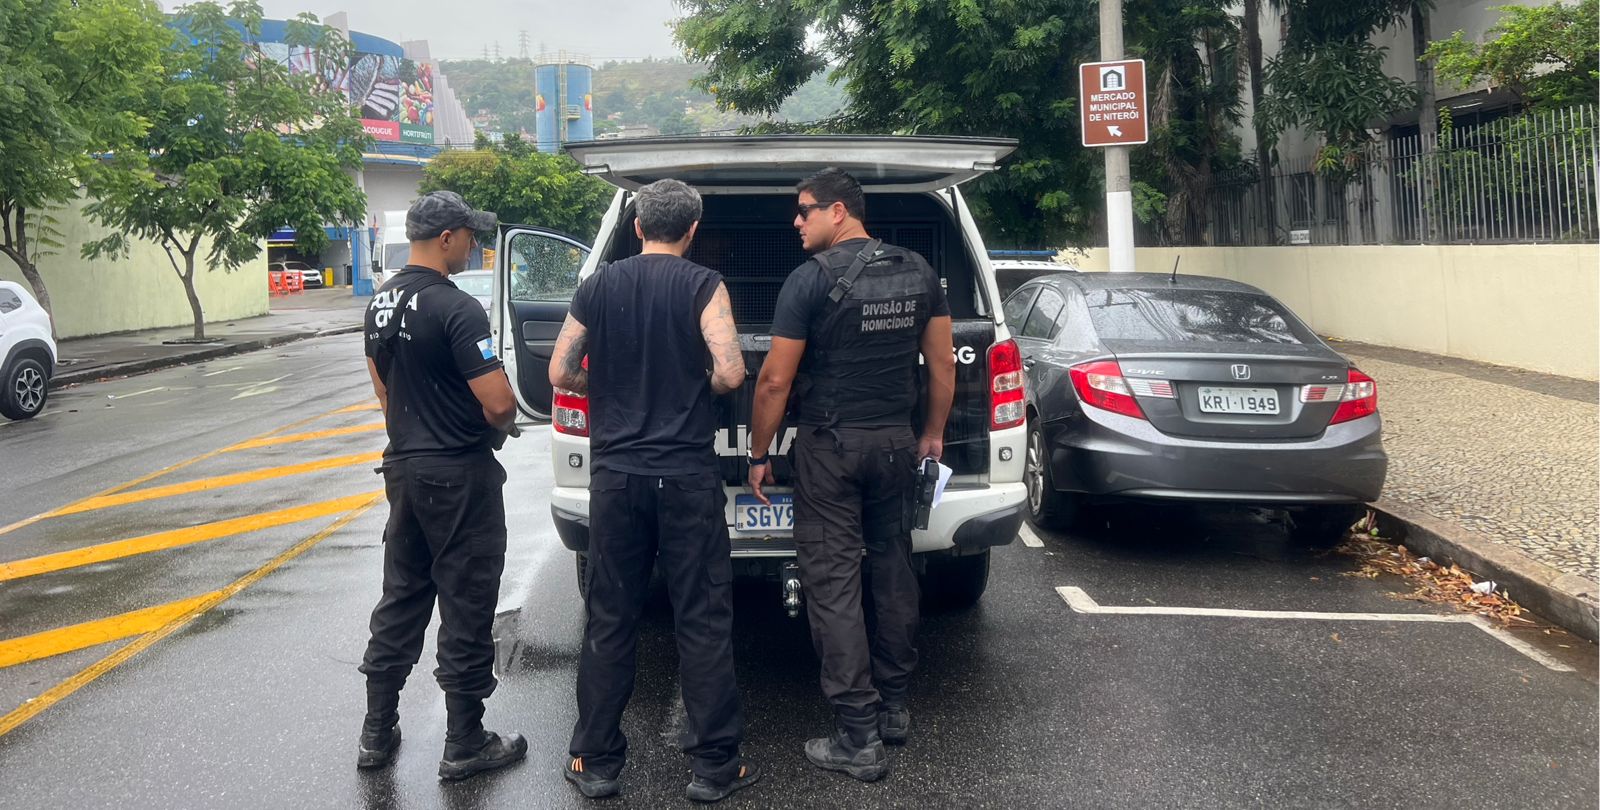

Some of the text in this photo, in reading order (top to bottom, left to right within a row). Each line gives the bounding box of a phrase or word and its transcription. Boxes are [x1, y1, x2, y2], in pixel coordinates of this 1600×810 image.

[1090, 92, 1136, 102] MERCADO
[1089, 102, 1138, 112] MUNICIPAL
[1089, 110, 1139, 121] DE NITERÓI
[862, 300, 917, 316] DIVISÃO DE
[861, 315, 915, 332] HOMICÍDIOS
